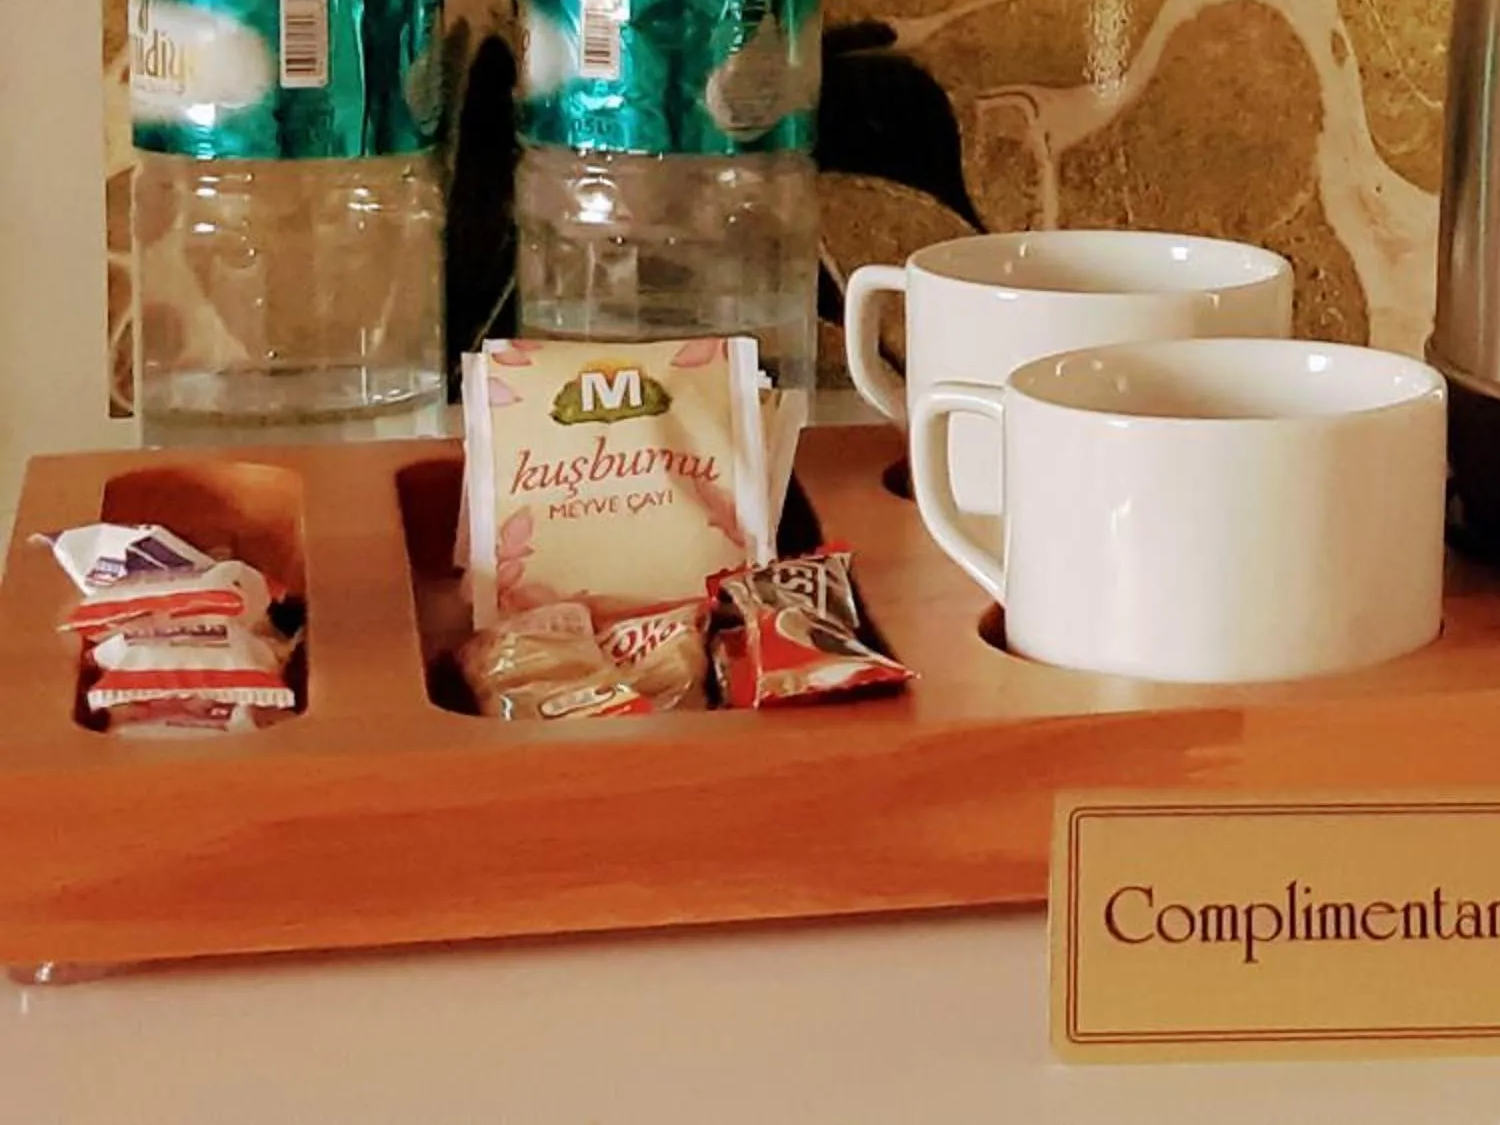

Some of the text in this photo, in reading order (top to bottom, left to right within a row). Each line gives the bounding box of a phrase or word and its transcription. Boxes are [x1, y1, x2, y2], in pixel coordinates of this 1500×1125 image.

[580, 369, 644, 413] M
[510, 436, 720, 498] kuşburnu
[549, 489, 673, 520] MEYVE ÇAYI
